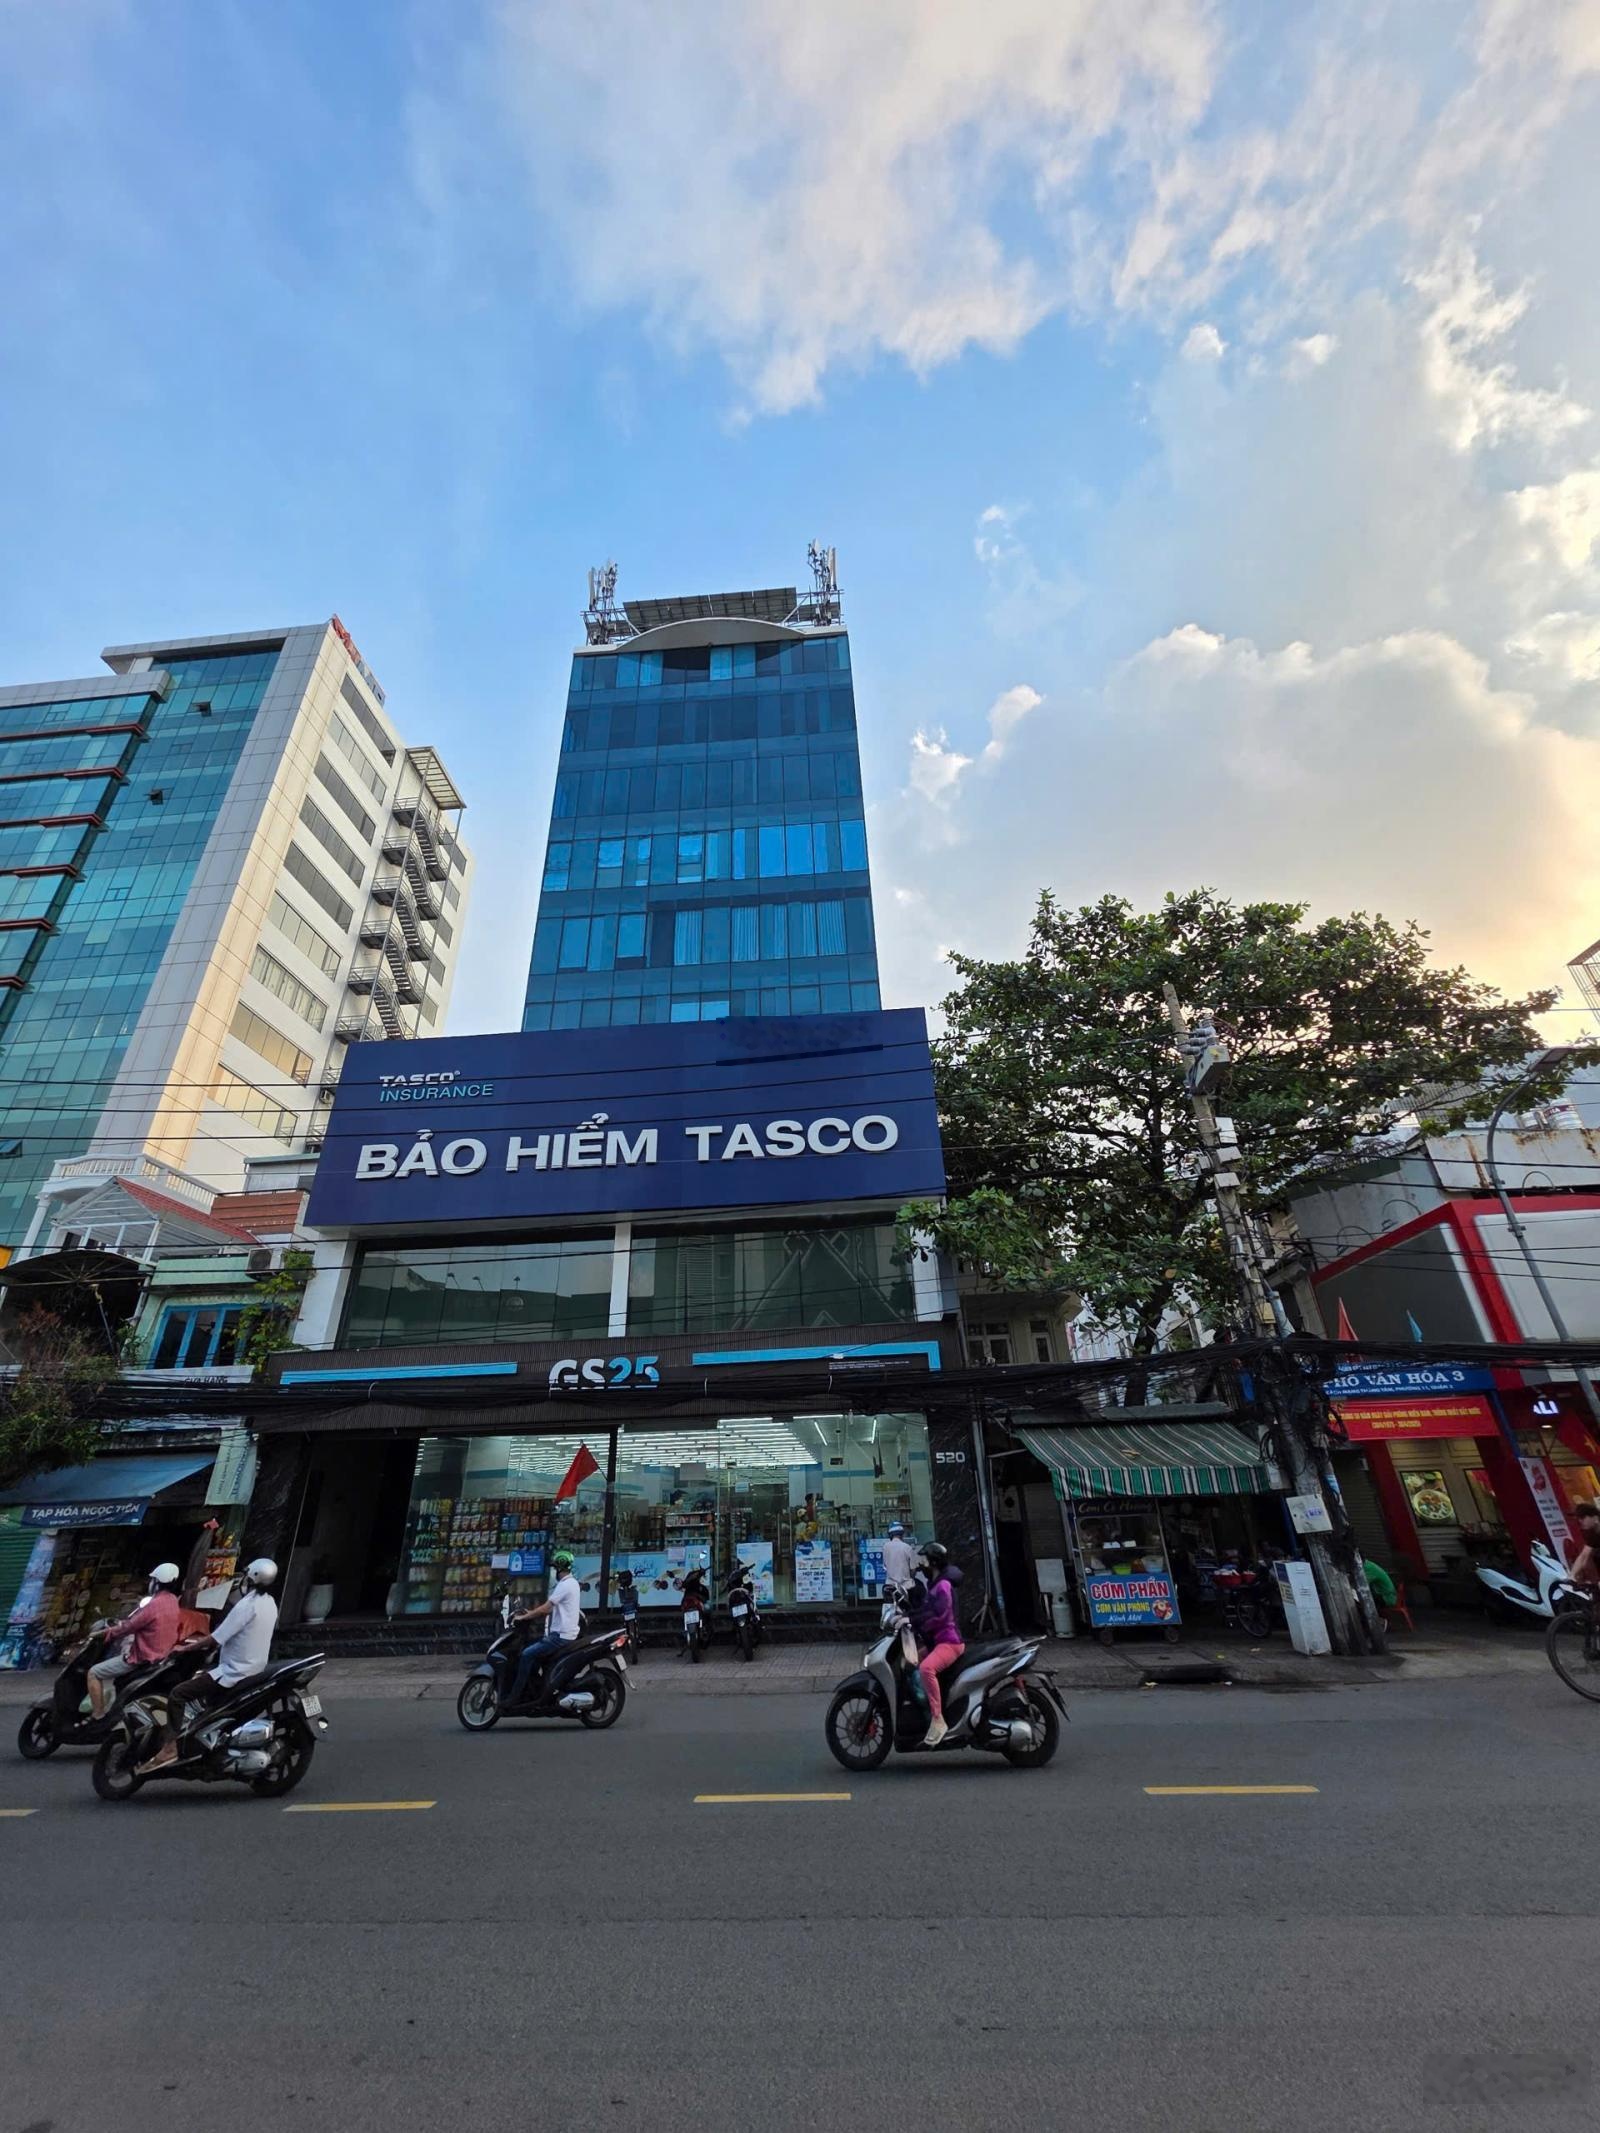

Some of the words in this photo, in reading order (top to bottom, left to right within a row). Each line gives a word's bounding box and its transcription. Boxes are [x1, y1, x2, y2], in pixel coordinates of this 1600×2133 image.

[380, 1072, 455, 1087] TASCO
[380, 1084, 494, 1102] INSURANCE
[355, 1129, 487, 1179] BẢO
[505, 1112, 659, 1172] HIỂM
[685, 1115, 899, 1161] TASCO
[549, 1355, 660, 1390] GS25
[1406, 1370, 1450, 1384] HÓA
[1452, 1370, 1465, 1382] 3
[935, 1451, 966, 1464] 520
[31, 1509, 53, 1519] TẠP
[54, 1506, 78, 1517] HÓA
[1091, 1582, 1126, 1600] CƠM
